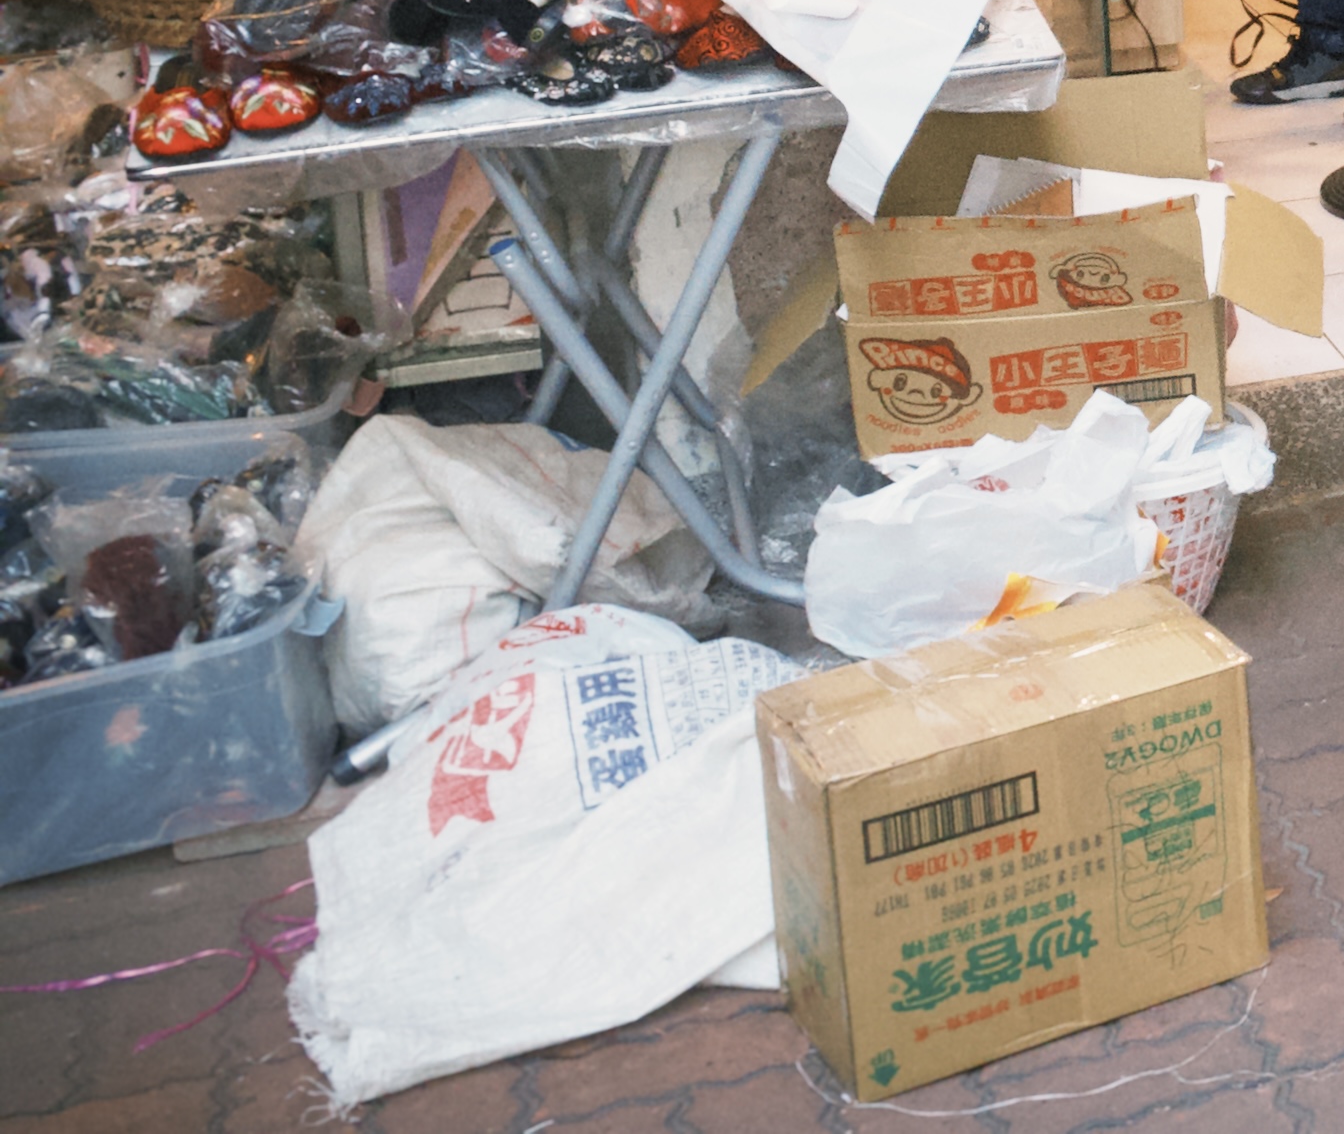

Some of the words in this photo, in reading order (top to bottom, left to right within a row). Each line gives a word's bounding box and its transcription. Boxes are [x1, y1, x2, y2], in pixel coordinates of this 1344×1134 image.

[863, 338, 962, 379] Prince
[890, 909, 1102, 1018] 妙管家
